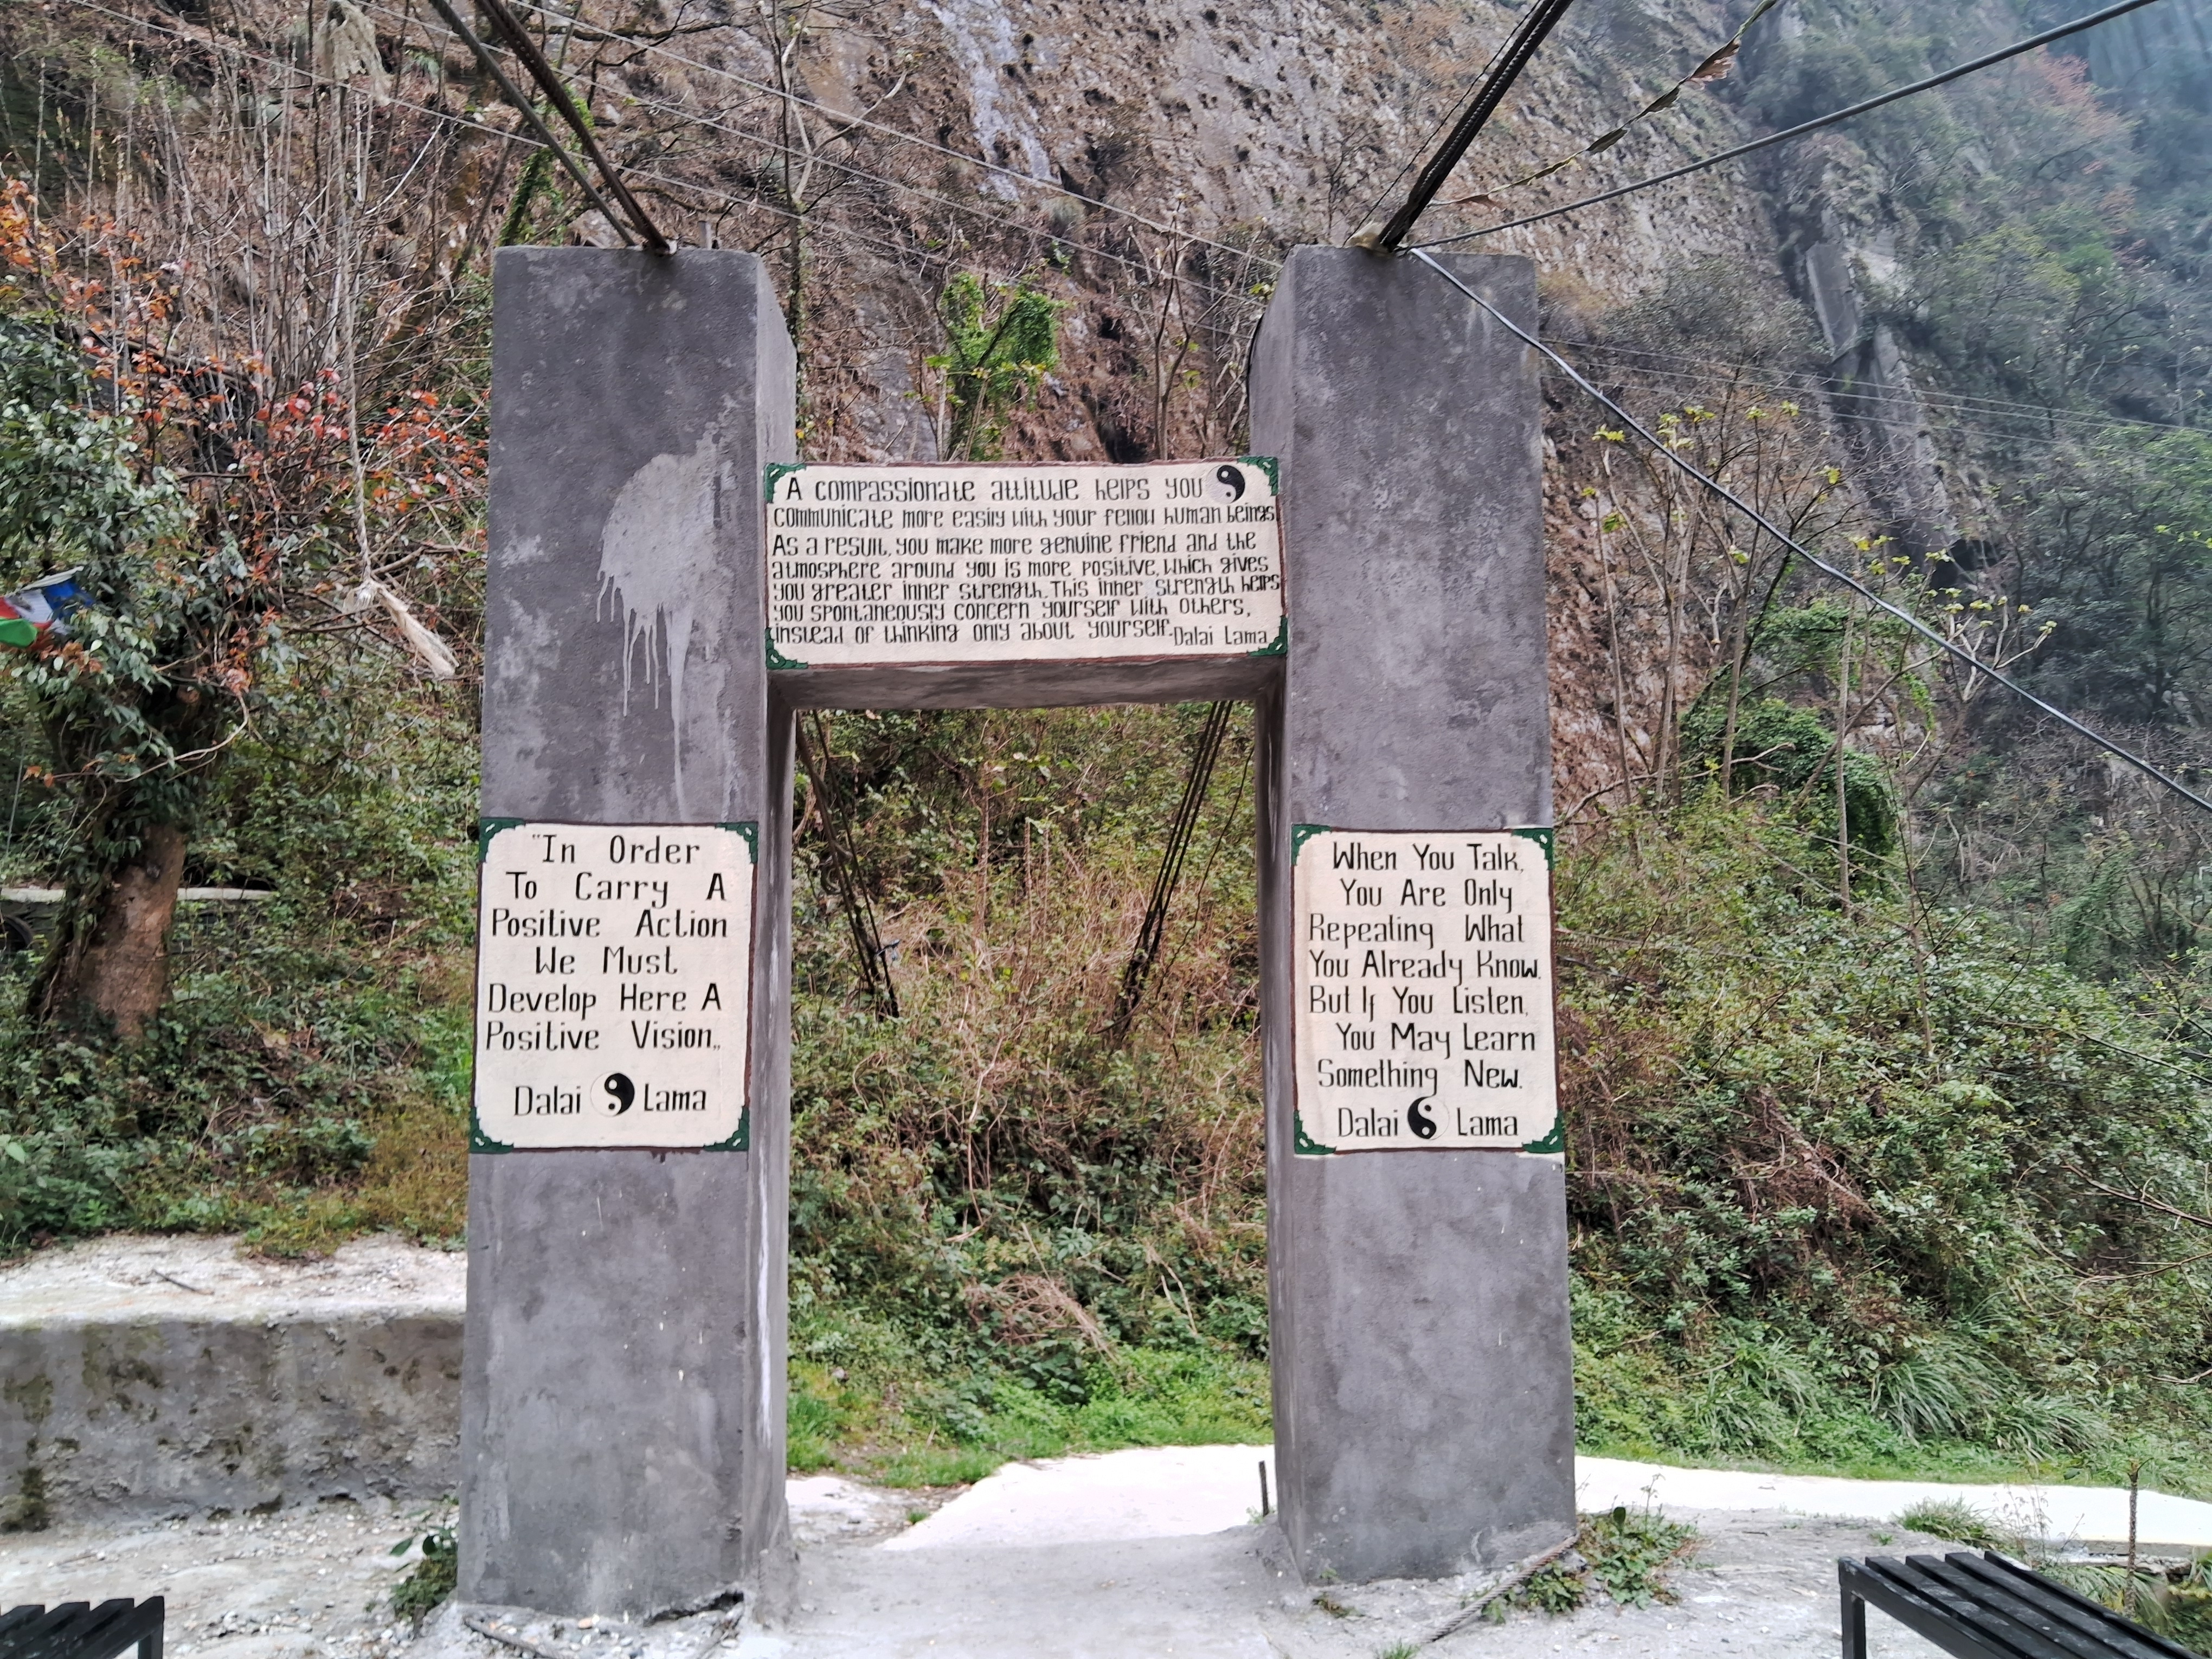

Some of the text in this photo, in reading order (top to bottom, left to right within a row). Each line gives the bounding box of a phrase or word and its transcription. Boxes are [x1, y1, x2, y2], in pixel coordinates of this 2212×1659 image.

[786, 477, 1203, 502] A compassionate attitude helps you
[774, 504, 893, 529] communicate
[902, 510, 943, 529] more
[953, 507, 1005, 528] easily
[1053, 510, 1097, 527] your
[1104, 509, 1155, 526] fellow
[1164, 507, 1221, 524] human
[772, 534, 798, 556] As
[806, 538, 818, 555] a
[896, 538, 928, 556] you
[936, 538, 983, 555] make
[990, 538, 1032, 555] more
[1040, 532, 1112, 555] genuine
[1120, 531, 1176, 553] friend
[1187, 533, 1217, 552] and
[1226, 532, 1256, 550] the
[772, 562, 881, 580] atmosphere
[892, 562, 955, 578] around
[966, 561, 995, 578] you
[1005, 558, 1020, 578] is
[1028, 561, 1071, 577] more
[1220, 553, 1268, 574] gives
[774, 583, 804, 601] you
[812, 583, 892, 602] greater
[903, 581, 949, 601] inner
[1050, 578, 1089, 597] This
[1098, 577, 1143, 596] inner
[1155, 576, 1234, 596] strength
[1241, 572, 1280, 593] helps
[774, 605, 803, 622] you
[811, 603, 944, 623] spontaneously
[954, 602, 1029, 621] concern
[1043, 600, 1120, 619] yourself
[775, 619, 1173, 646] instead of thinking only about yourself.
[1174, 626, 1268, 646] Dalai Lama
[610, 835, 700, 864] Order
[1333, 841, 1523, 873] When You Talk,
[506, 871, 726, 909] To Carry A
[1340, 878, 1512, 914] You Are Only
[493, 908, 726, 937] Positive Action
[1309, 914, 1524, 950] Repeating What
[536, 946, 677, 974] We Must
[1309, 947, 1541, 989] You Already Know.
[488, 983, 721, 1021] Develop Here A
[1310, 983, 1528, 1022] But If You Listen,
[486, 1020, 599, 1051] Positive
[1335, 1022, 1535, 1059] You May Learn
[1318, 1059, 1522, 1099] Something New.
[515, 1083, 706, 1116] Dalai Lama
[1339, 1108, 1518, 1137] Dalai Lama
